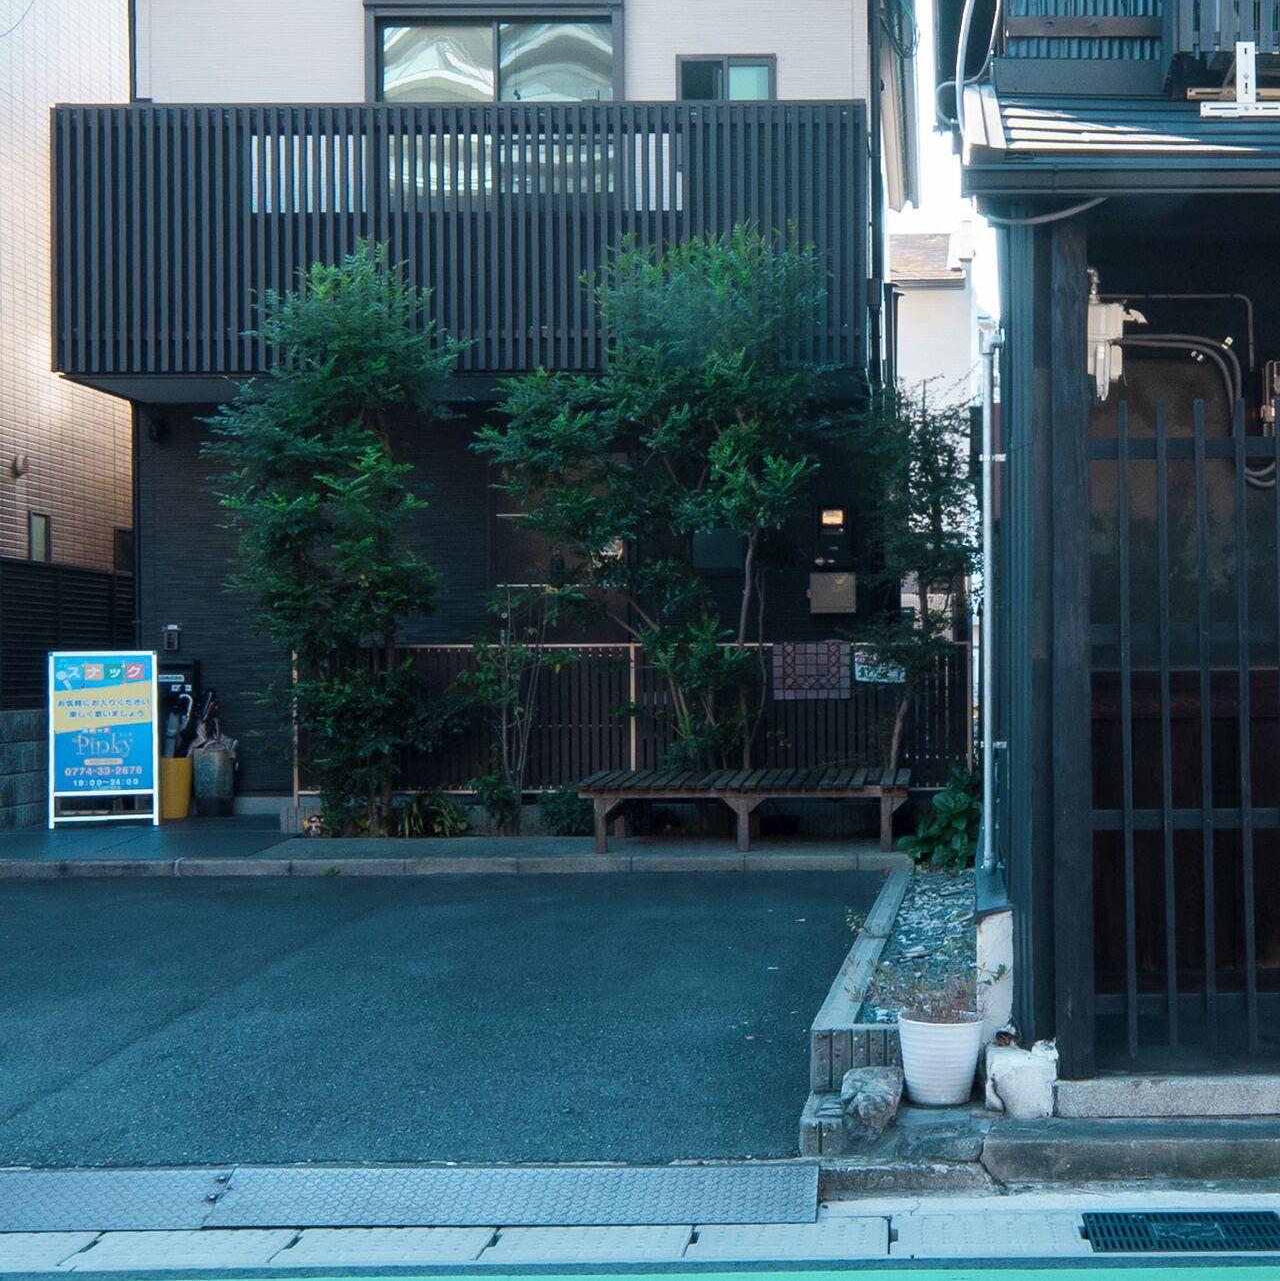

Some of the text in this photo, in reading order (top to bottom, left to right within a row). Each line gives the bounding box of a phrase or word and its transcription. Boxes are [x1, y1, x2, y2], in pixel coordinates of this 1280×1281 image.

[67, 666, 142, 678] スナック
[73, 732, 133, 757] Pinky
